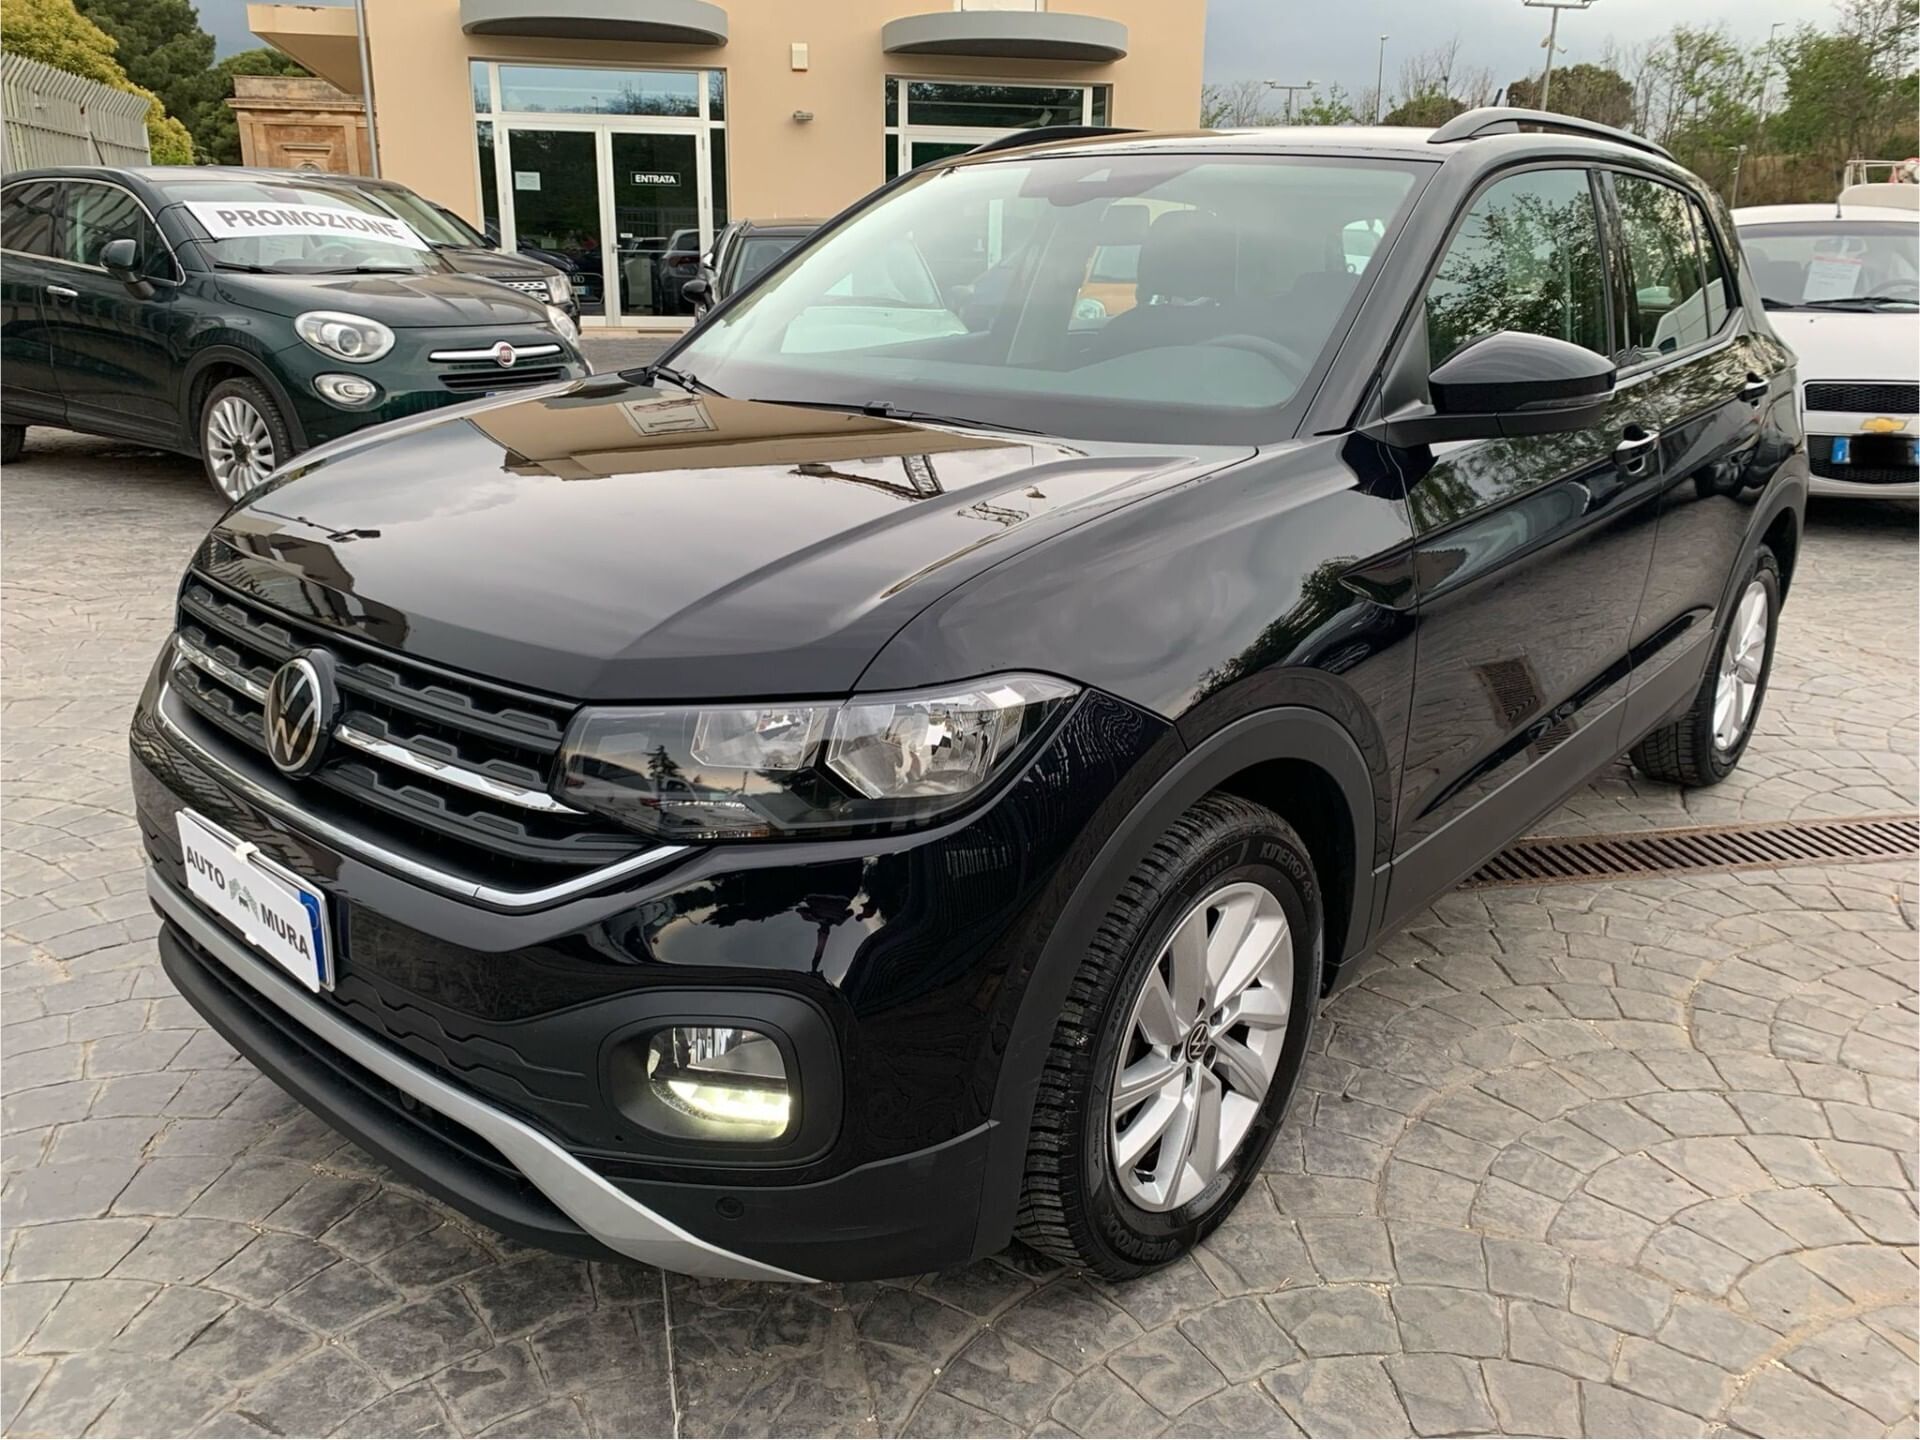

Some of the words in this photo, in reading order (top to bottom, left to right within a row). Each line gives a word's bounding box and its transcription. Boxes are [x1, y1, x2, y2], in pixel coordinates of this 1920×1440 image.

[635, 174, 676, 184] ENTRATA
[216, 209, 405, 240] PROMOZIONE
[186, 845, 226, 891] AUTO
[260, 902, 311, 961] MURA
